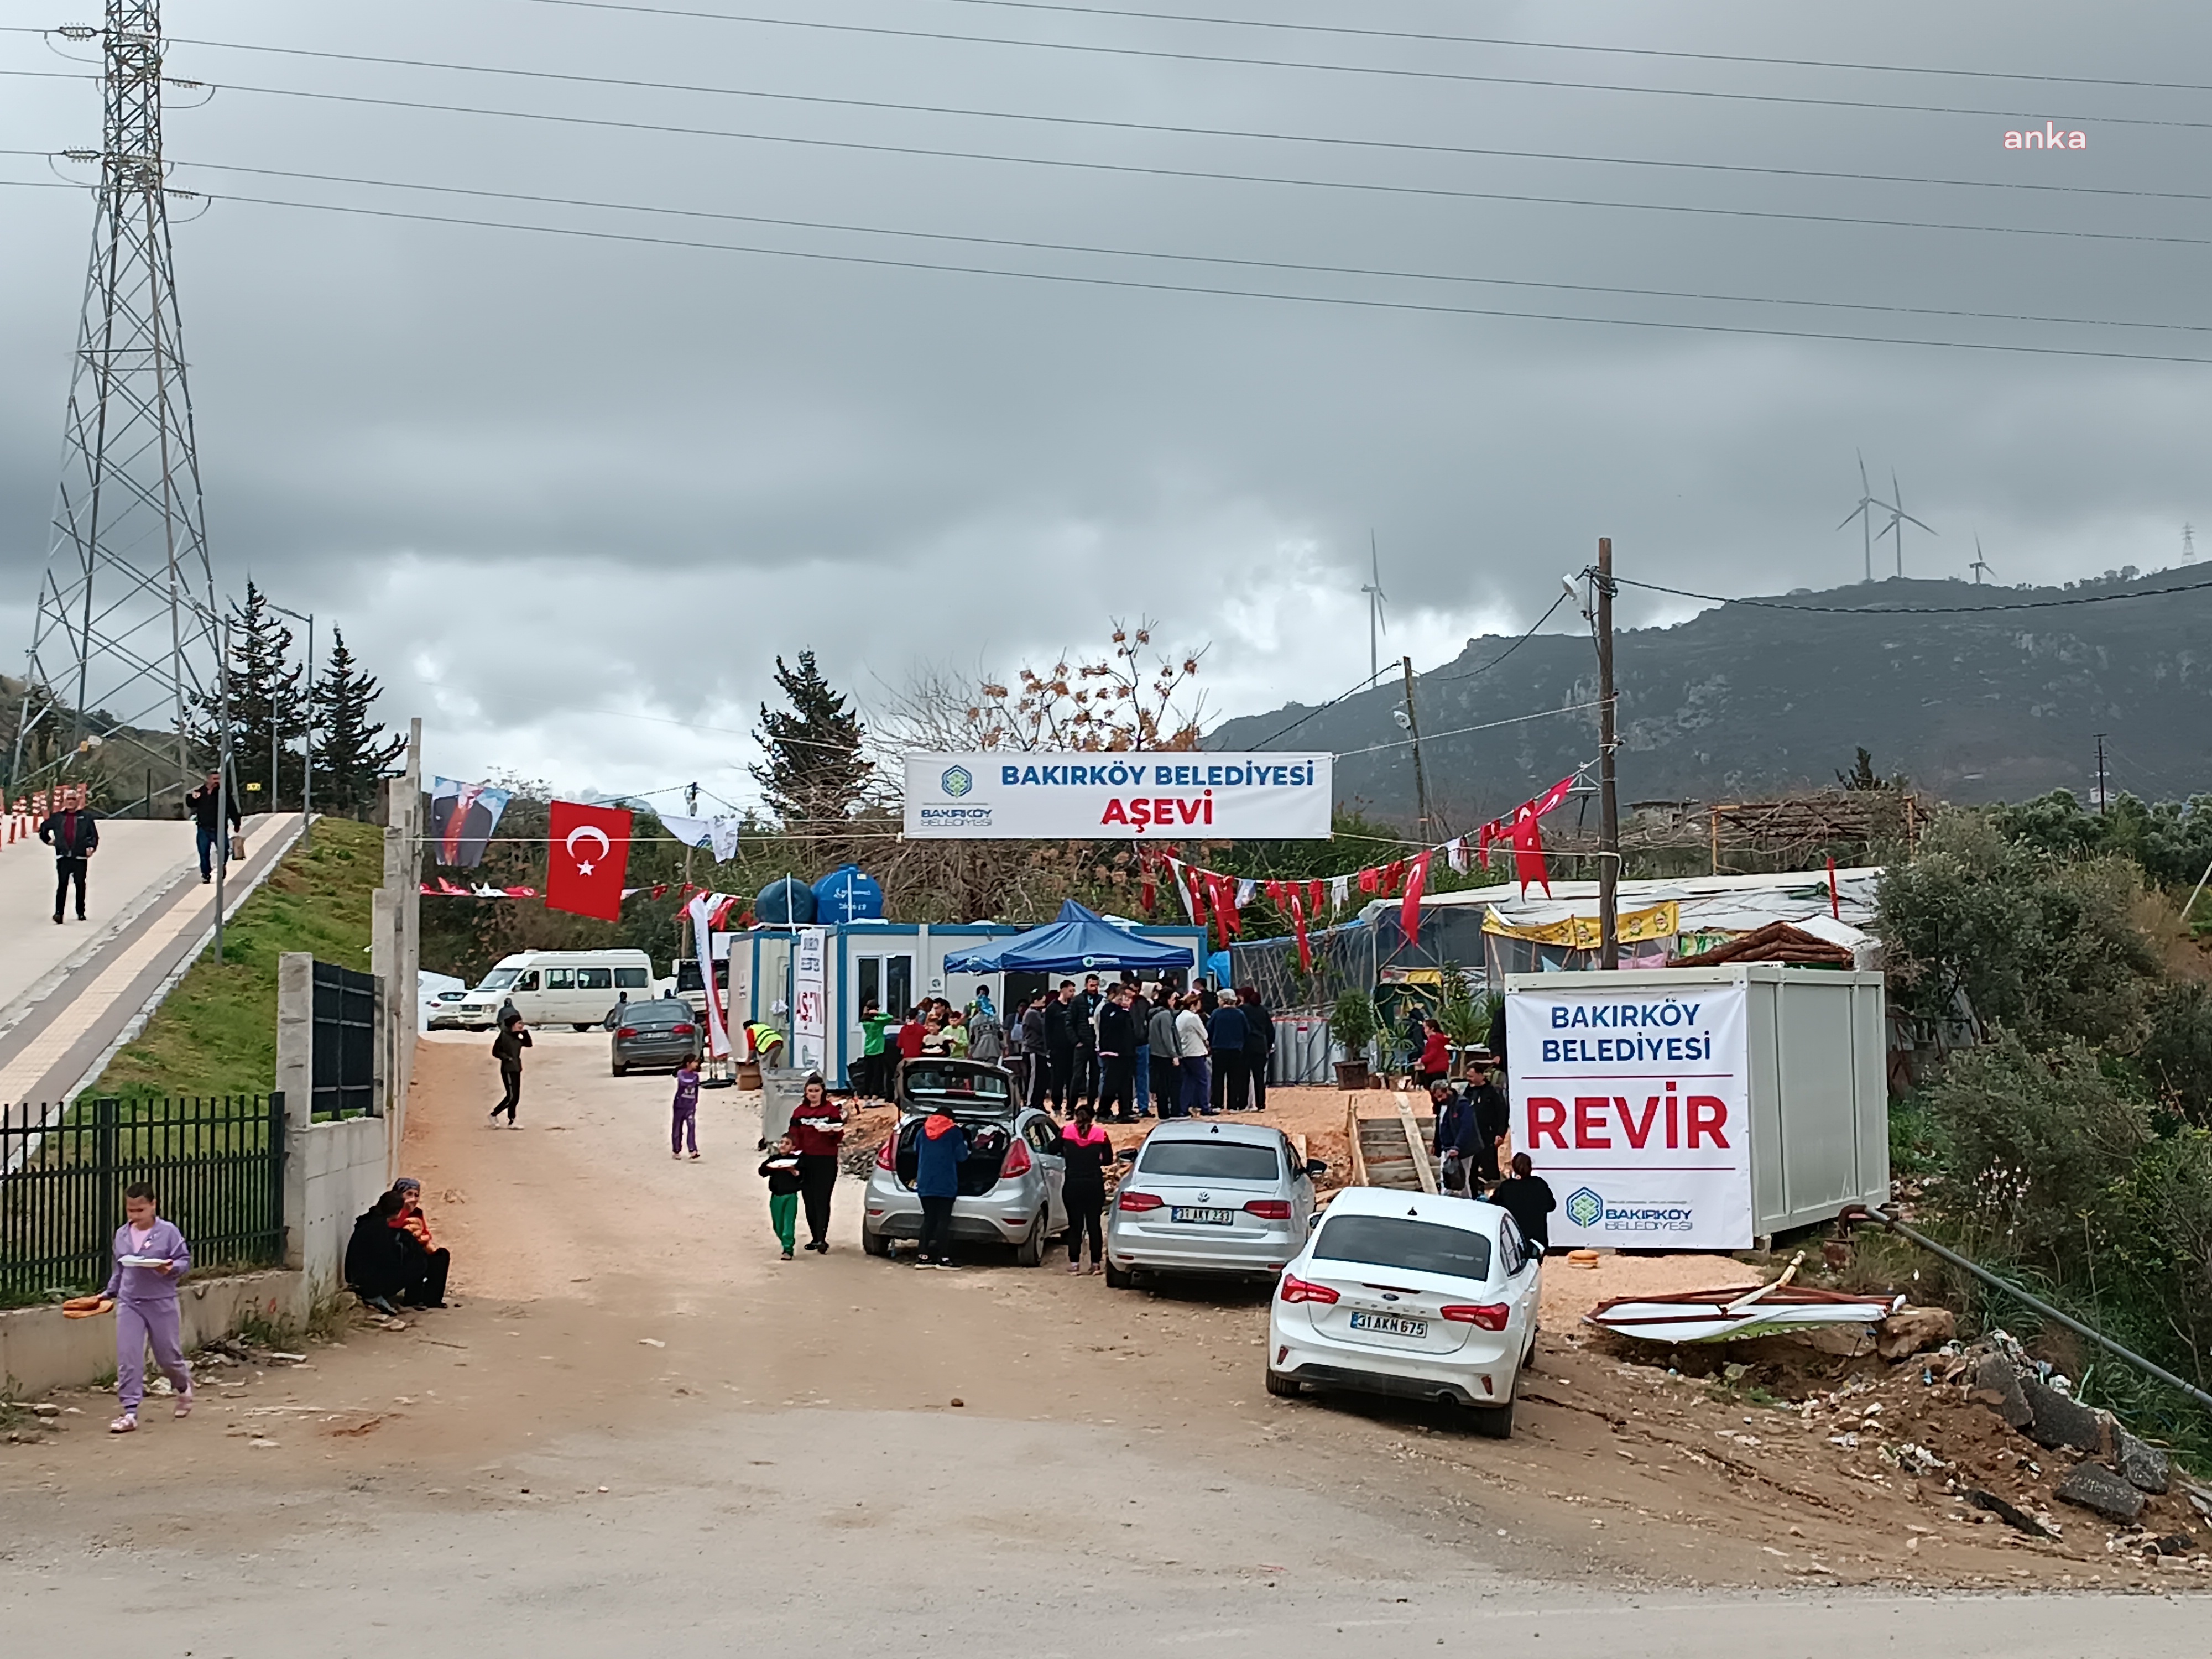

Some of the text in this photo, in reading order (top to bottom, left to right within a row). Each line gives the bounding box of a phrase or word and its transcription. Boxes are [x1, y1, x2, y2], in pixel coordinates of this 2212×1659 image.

[1002, 759, 1314, 786] BAKIRKÖY BELEDİYESİ
[1100, 789, 1214, 833] AŞEVİ
[1551, 997, 1701, 1028] BAKIRKÖY
[1542, 1030, 1711, 1062] BELEDİYESİ
[1526, 1081, 1730, 1150] REVİR
[1400, 1320, 1425, 1335] 675
